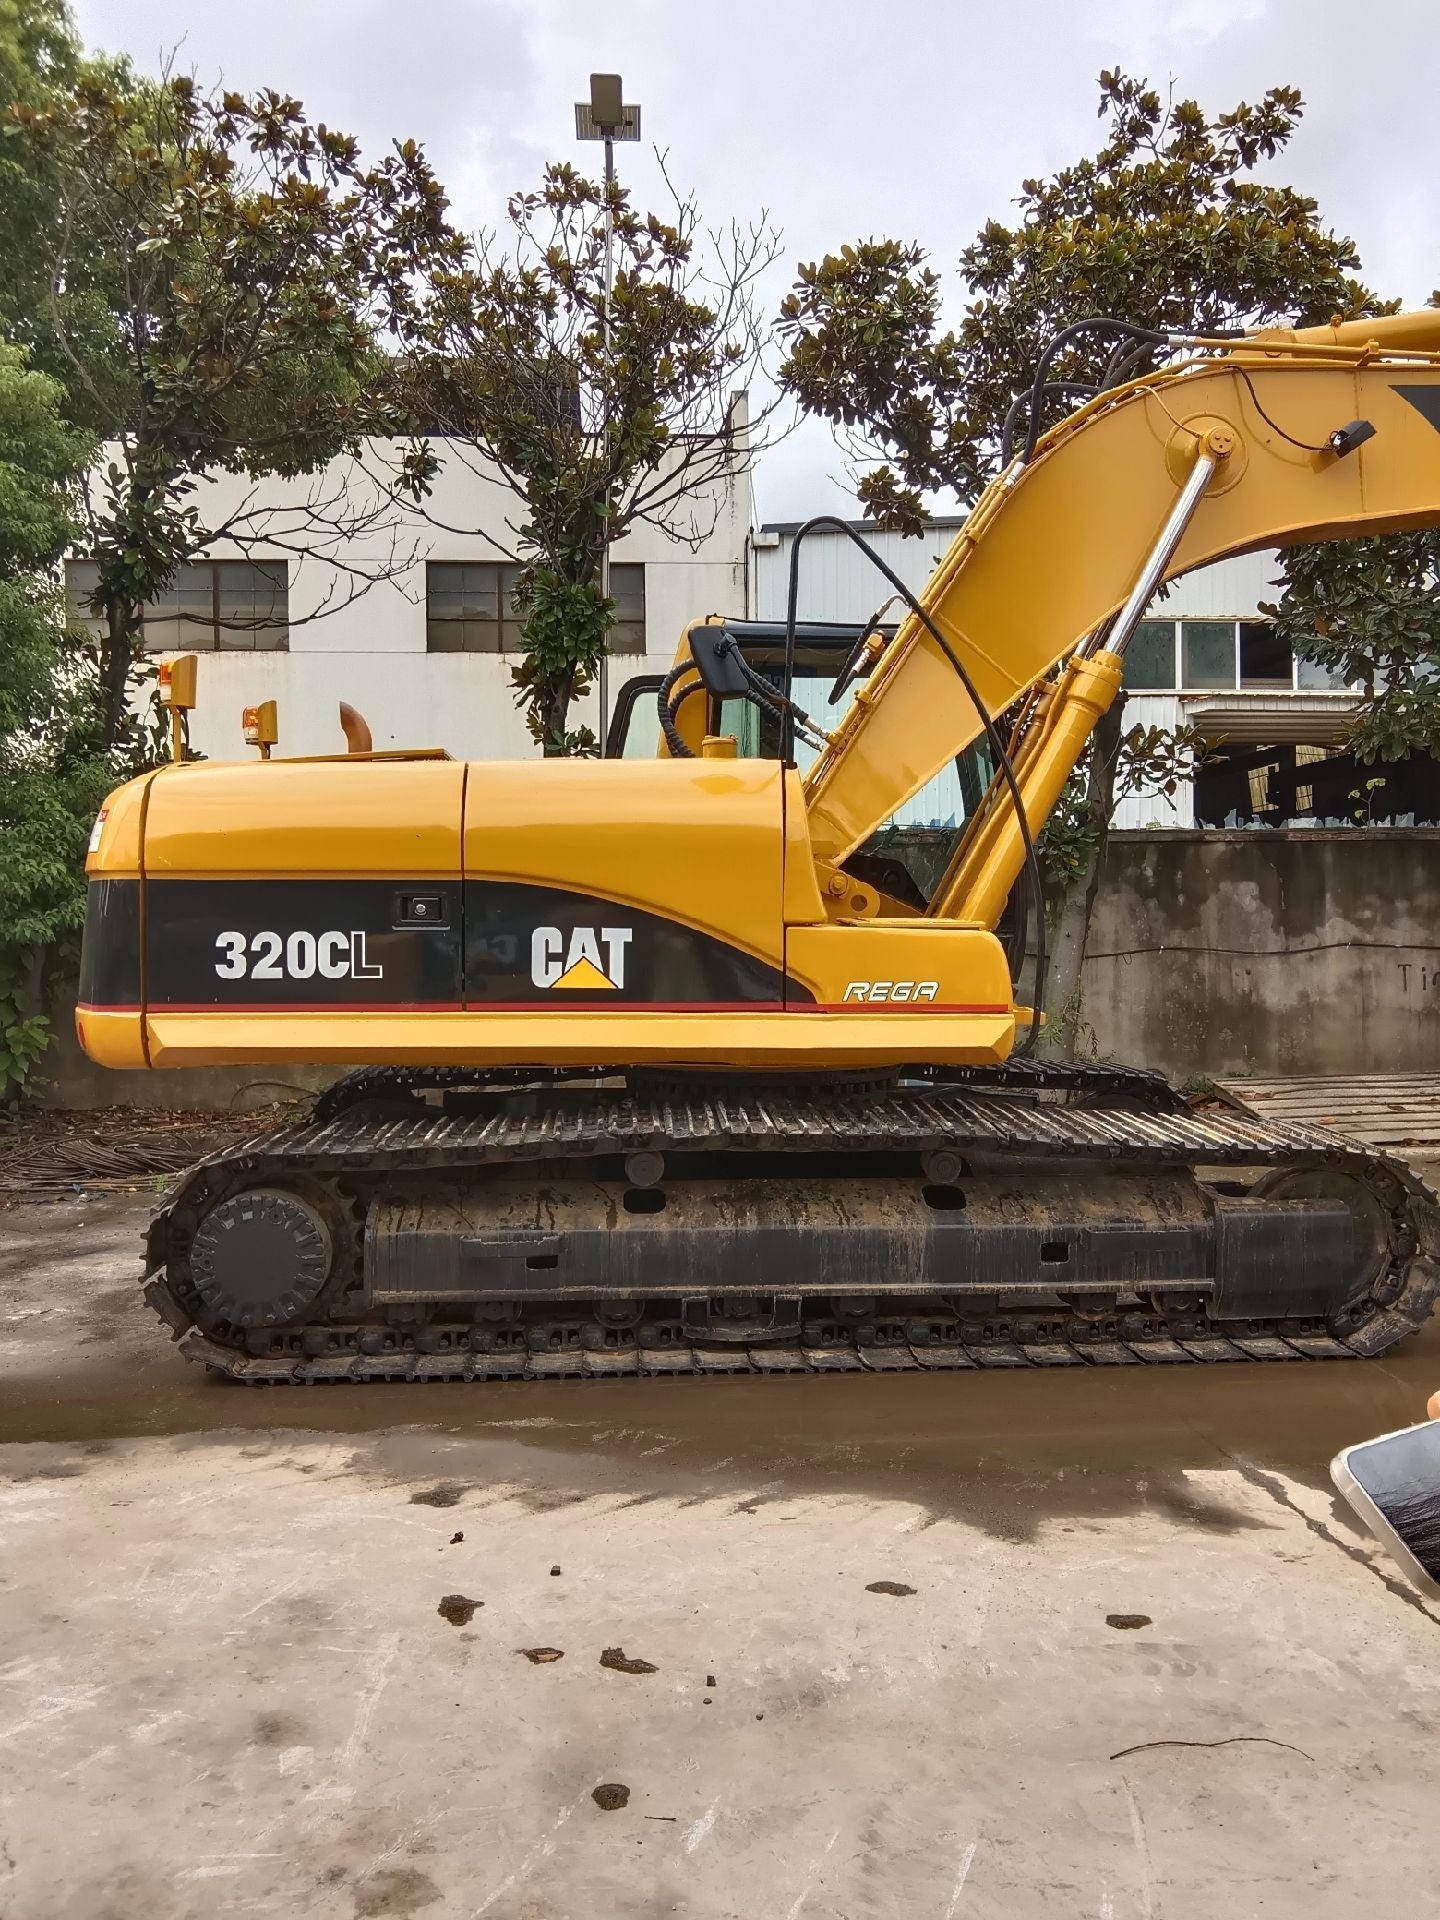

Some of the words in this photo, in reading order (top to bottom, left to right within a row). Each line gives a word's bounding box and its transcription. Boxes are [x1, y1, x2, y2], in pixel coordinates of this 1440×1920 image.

[214, 930, 383, 979] 320CL
[531, 926, 632, 989] CAT
[842, 981, 940, 1002] REGA
